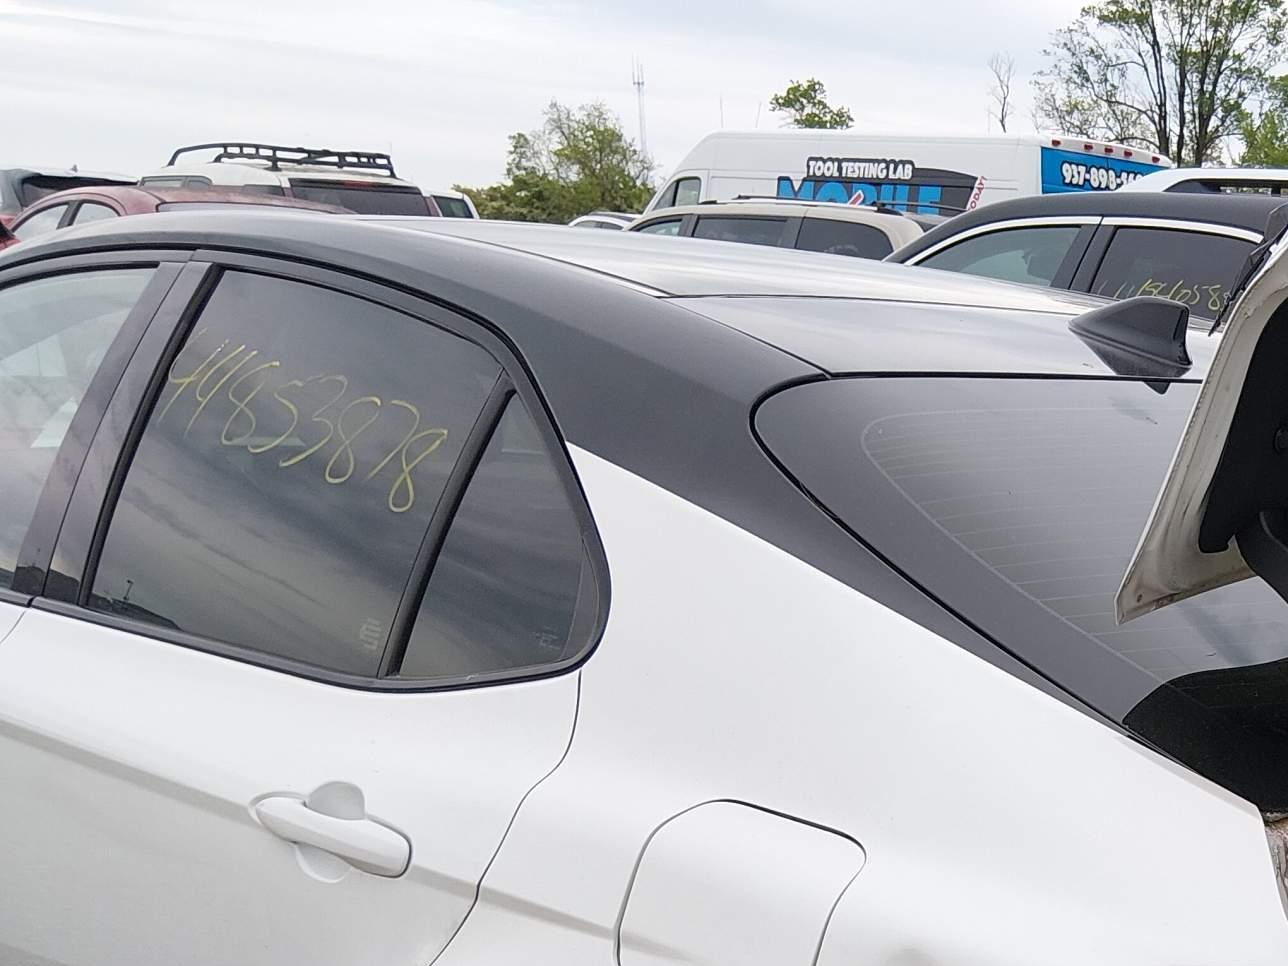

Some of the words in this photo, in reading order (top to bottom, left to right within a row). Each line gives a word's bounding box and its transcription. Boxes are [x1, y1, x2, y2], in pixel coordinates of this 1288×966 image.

[808, 160, 839, 177] TOOL
[841, 162, 887, 179] TESTING
[888, 163, 913, 180] LAB
[155, 327, 449, 513] 44853878
